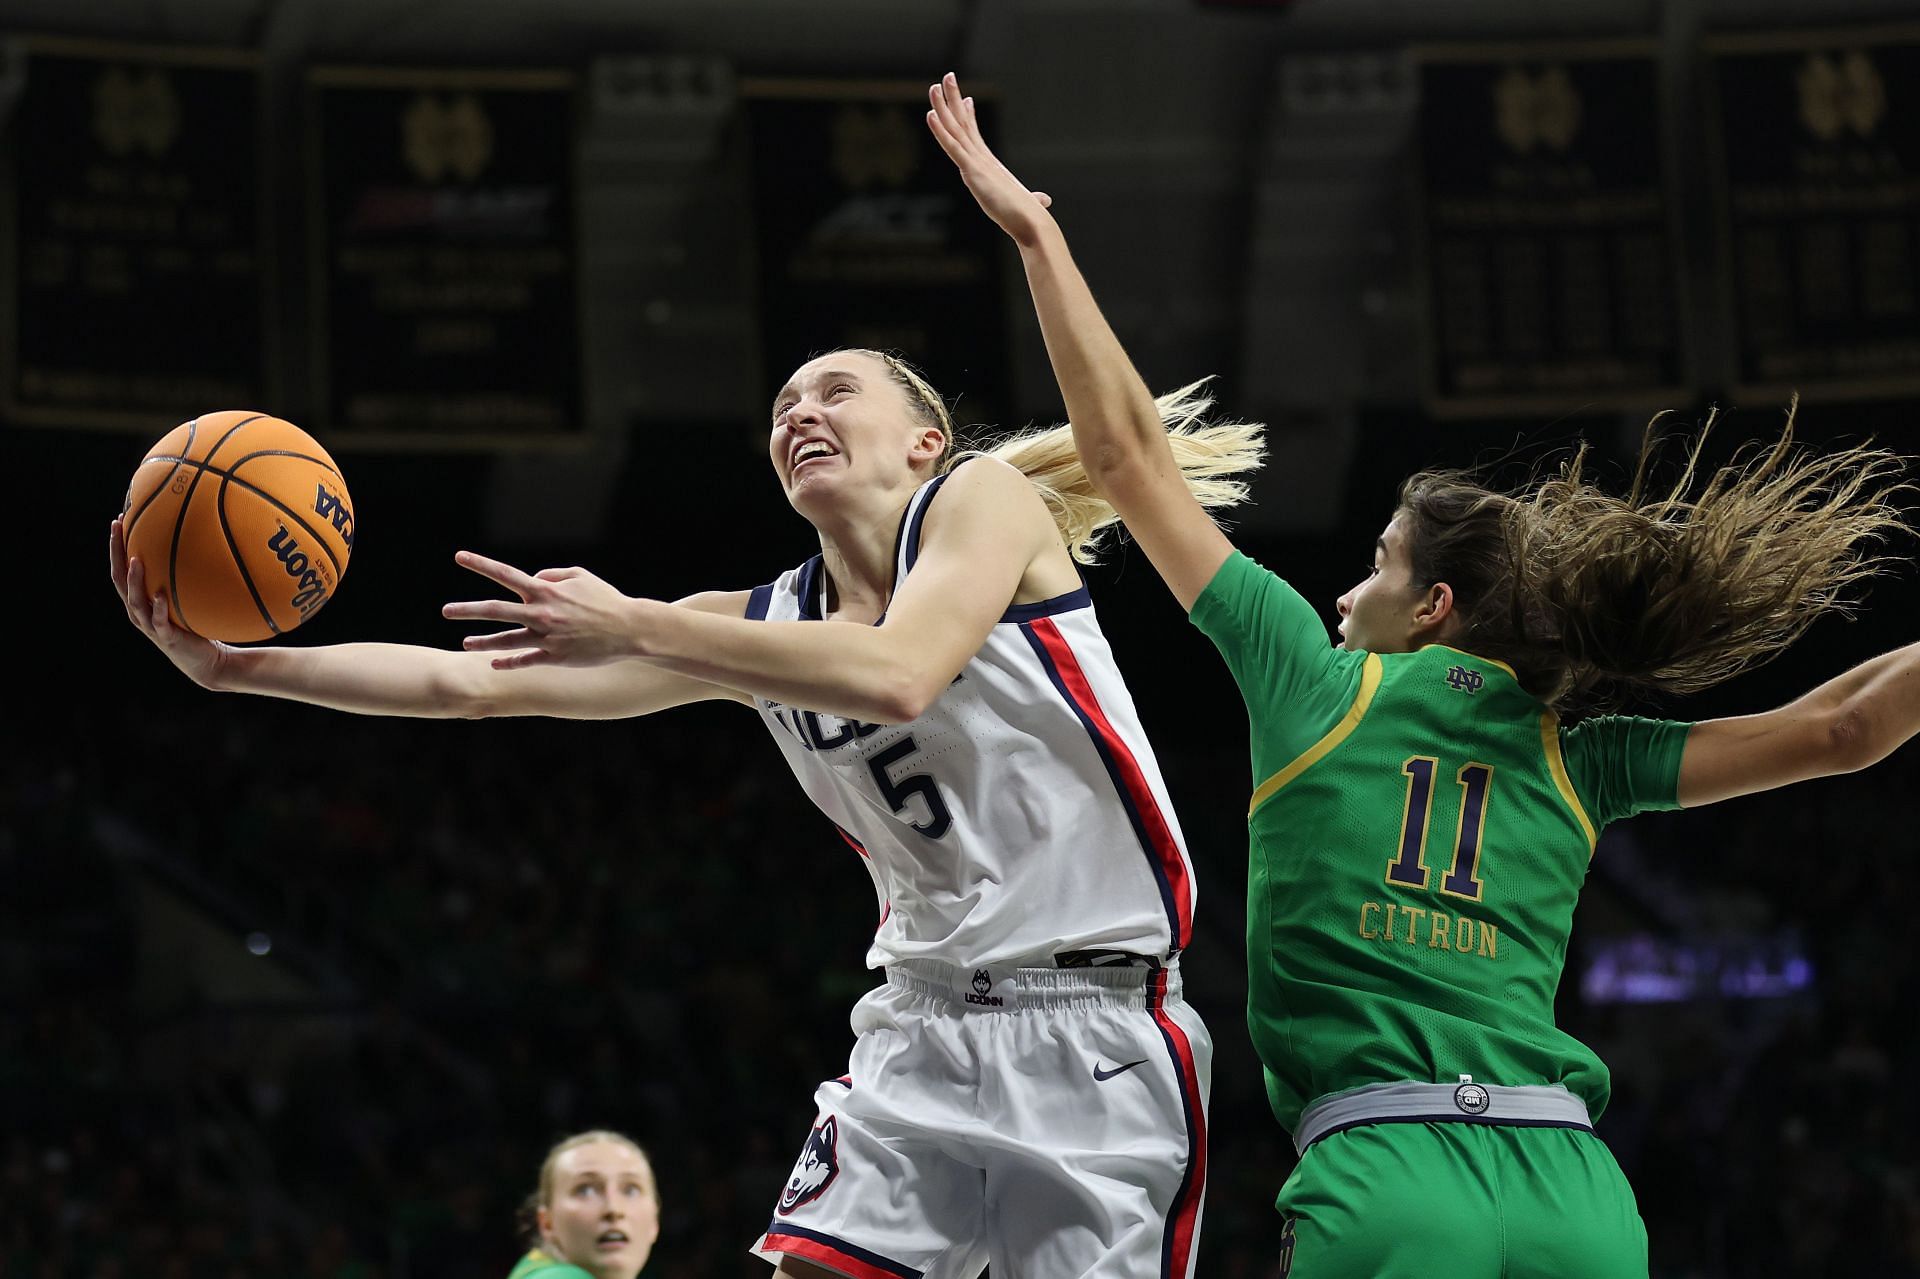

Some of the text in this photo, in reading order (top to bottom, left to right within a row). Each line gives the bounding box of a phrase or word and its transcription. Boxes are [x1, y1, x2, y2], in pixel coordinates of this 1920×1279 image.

[268, 522, 328, 622] ilson
[865, 731, 954, 841] 5
[1385, 754, 1495, 902] 11
[1359, 901, 1498, 960] CITRON
[964, 992, 1004, 1007] UCONN
